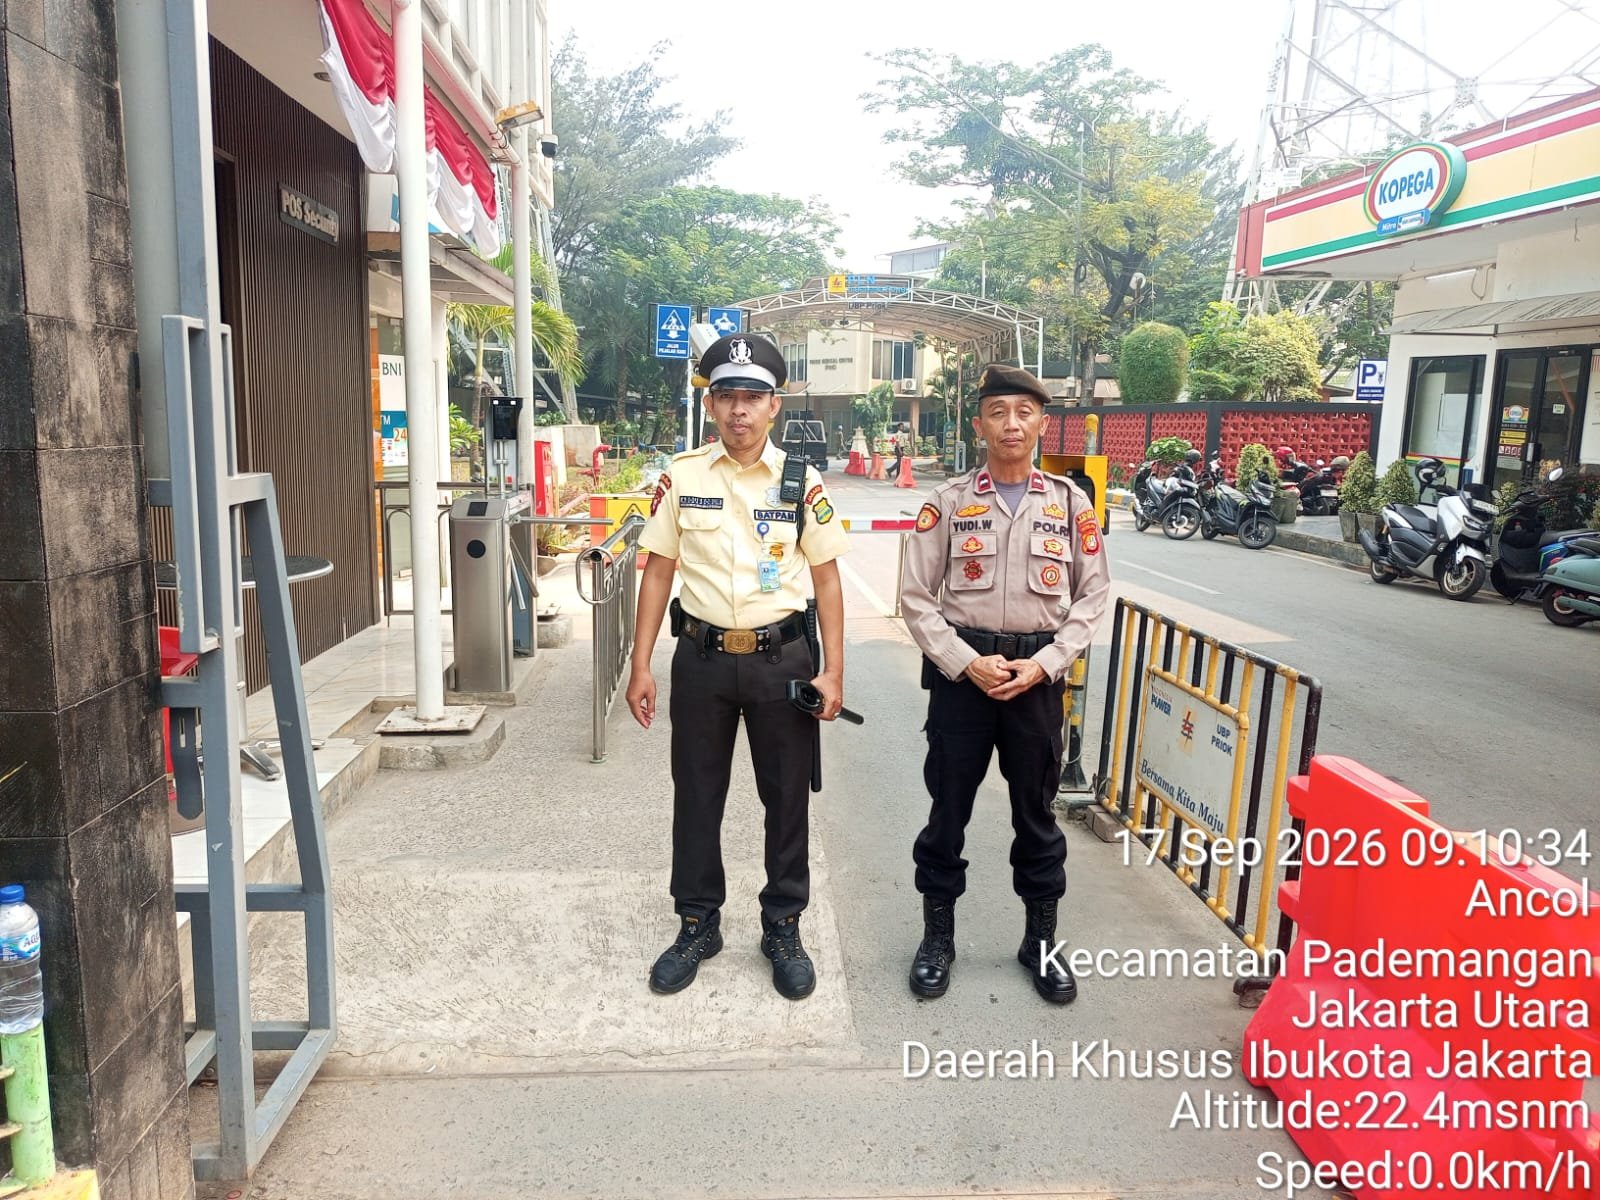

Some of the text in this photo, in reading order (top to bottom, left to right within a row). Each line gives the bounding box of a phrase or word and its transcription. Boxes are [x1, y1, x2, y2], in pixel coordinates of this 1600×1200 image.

[1378, 168, 1434, 205] KOPEGA
[282, 190, 339, 242] POS Security
[382, 362, 402, 376] BNI
[1361, 363, 1378, 384] P
[393, 428, 407, 442] 24
[953, 520, 993, 532] YUDI.W
[1217, 724, 1231, 737] UBP
[1211, 736, 1232, 756] PRIOK
[1141, 759, 1224, 833] Bersama Kita Maju
